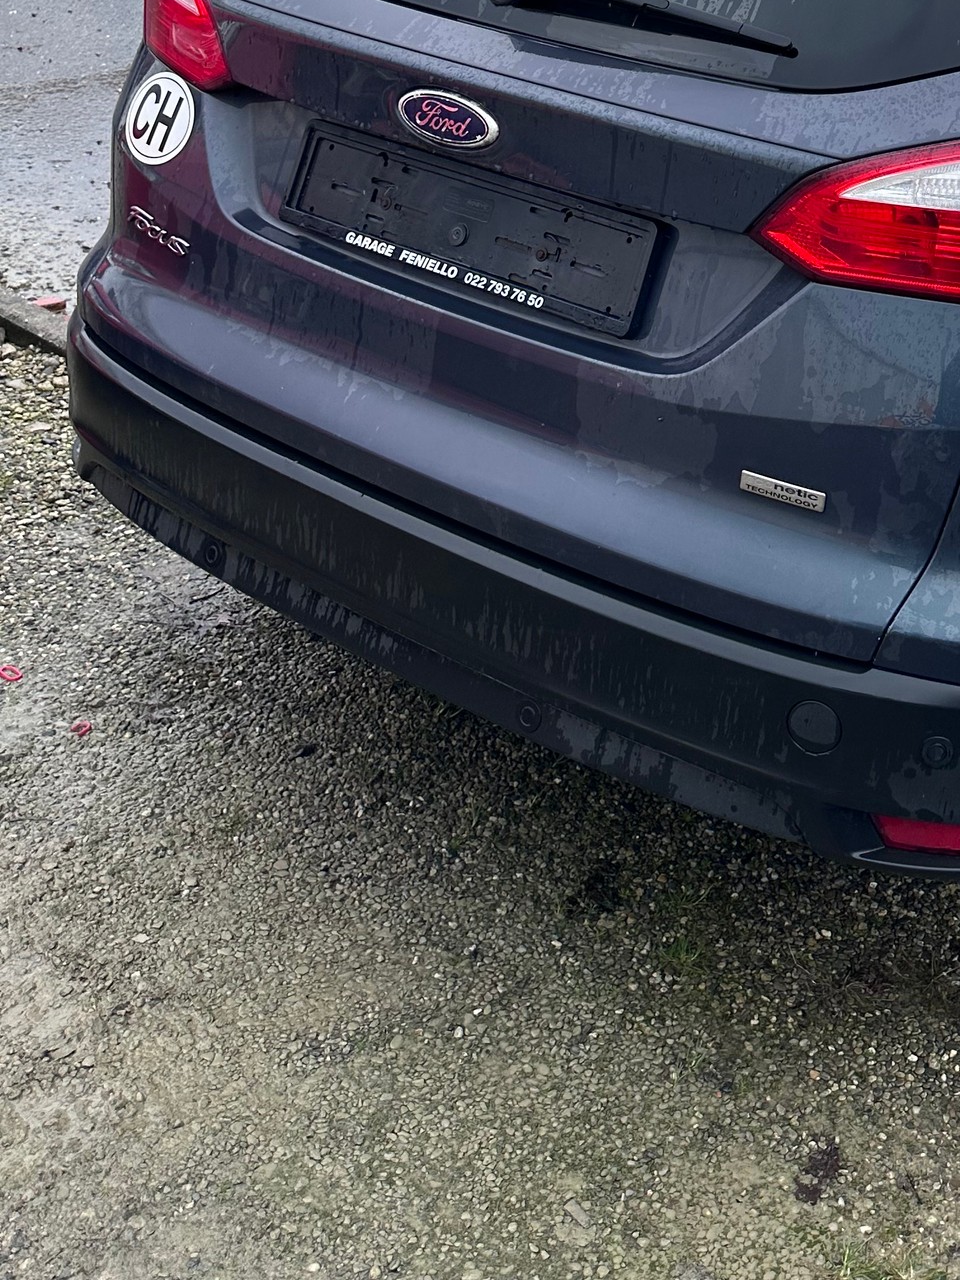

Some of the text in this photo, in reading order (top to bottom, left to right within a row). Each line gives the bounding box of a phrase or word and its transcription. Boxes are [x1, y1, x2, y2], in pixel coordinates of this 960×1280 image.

[132, 83, 184, 153] CH
[415, 99, 469, 137] Ford
[345, 231, 544, 309] GARAGE FENIELLO 022 793 76 50
[745, 483, 818, 509] TECHNOLOGY
